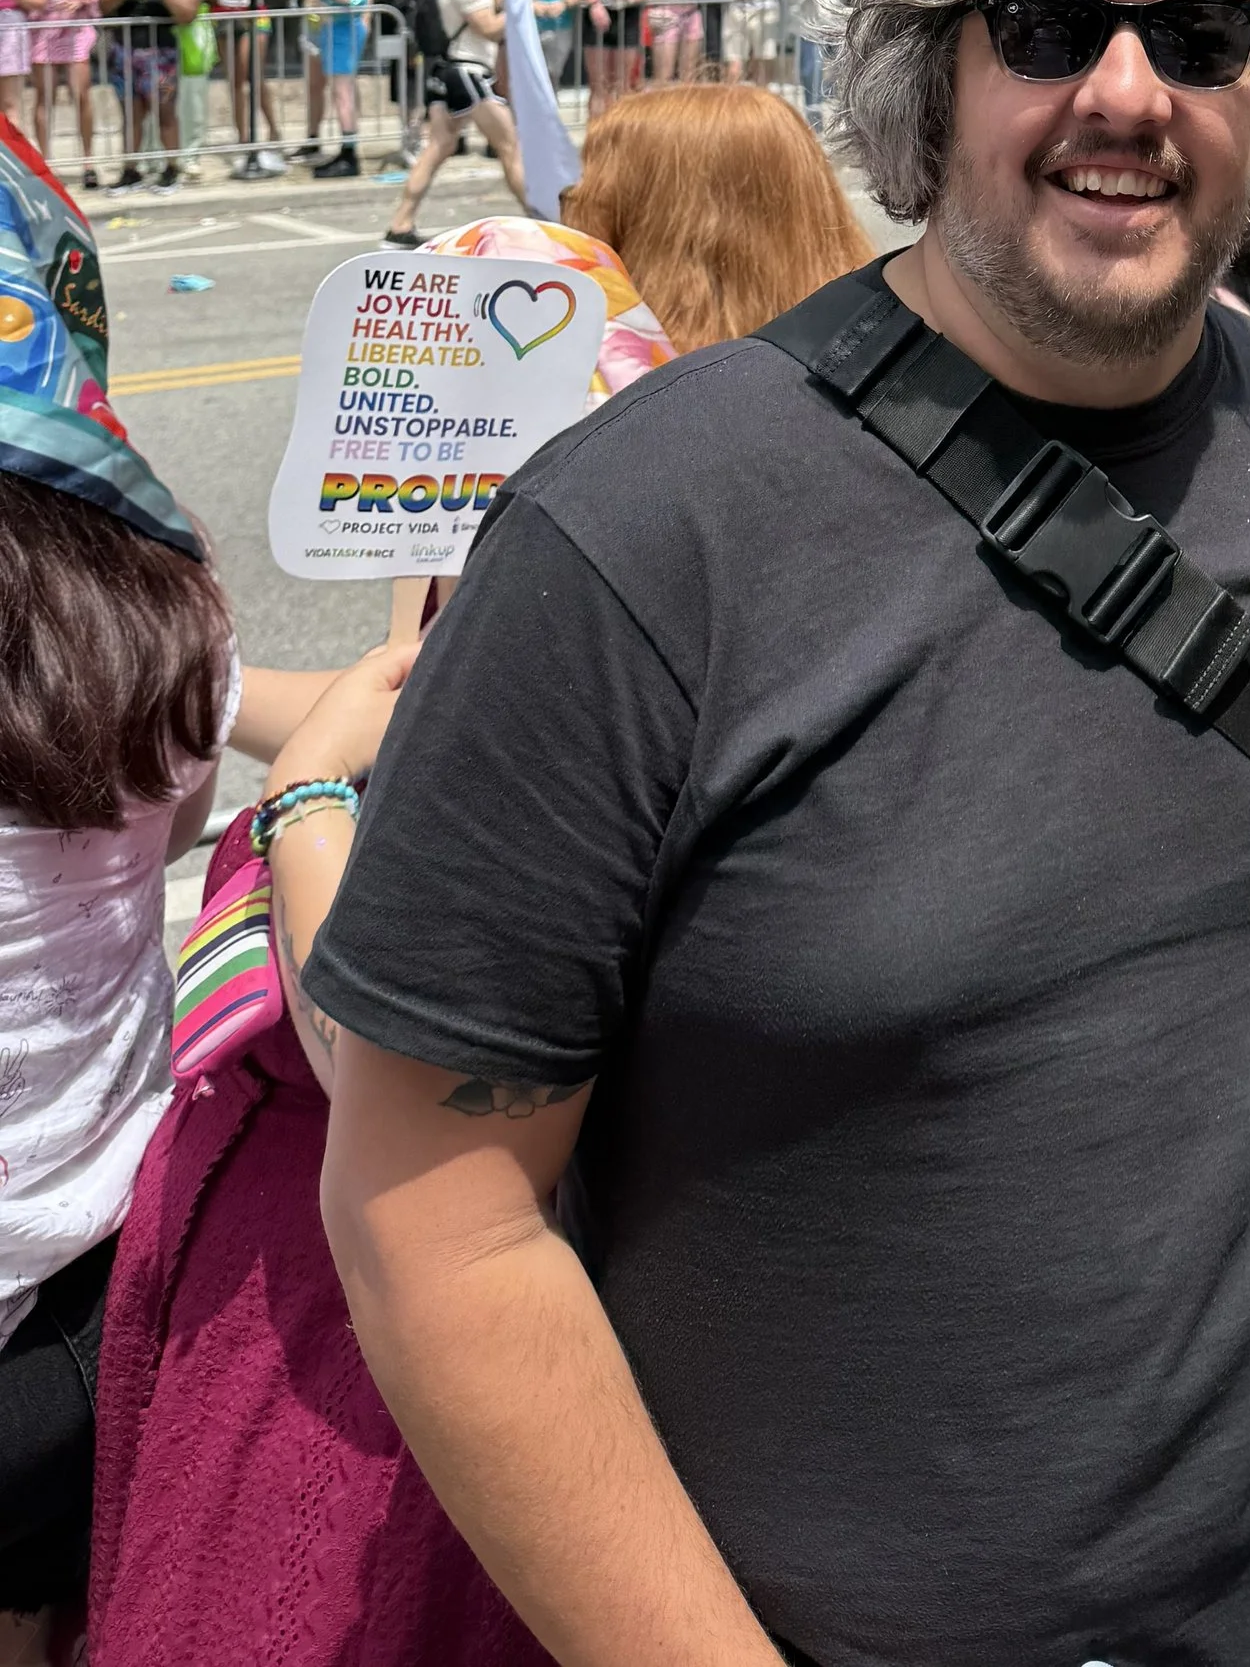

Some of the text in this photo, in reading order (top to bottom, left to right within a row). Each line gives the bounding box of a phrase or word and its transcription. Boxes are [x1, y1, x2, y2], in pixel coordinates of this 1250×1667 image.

[364, 269, 460, 294] WE ARE
[62, 283, 108, 337] Sardi
[357, 294, 460, 319] JOYFUL.
[352, 319, 475, 343] HEALTHY.
[347, 343, 485, 367] LIBERATED.
[343, 367, 420, 389] BOLD.
[339, 391, 439, 414] UNITED.
[334, 415, 519, 438] UNSTOPPABLE.
[328, 439, 467, 461] FREE TO BE
[341, 521, 440, 534] PROJECT VIDA
